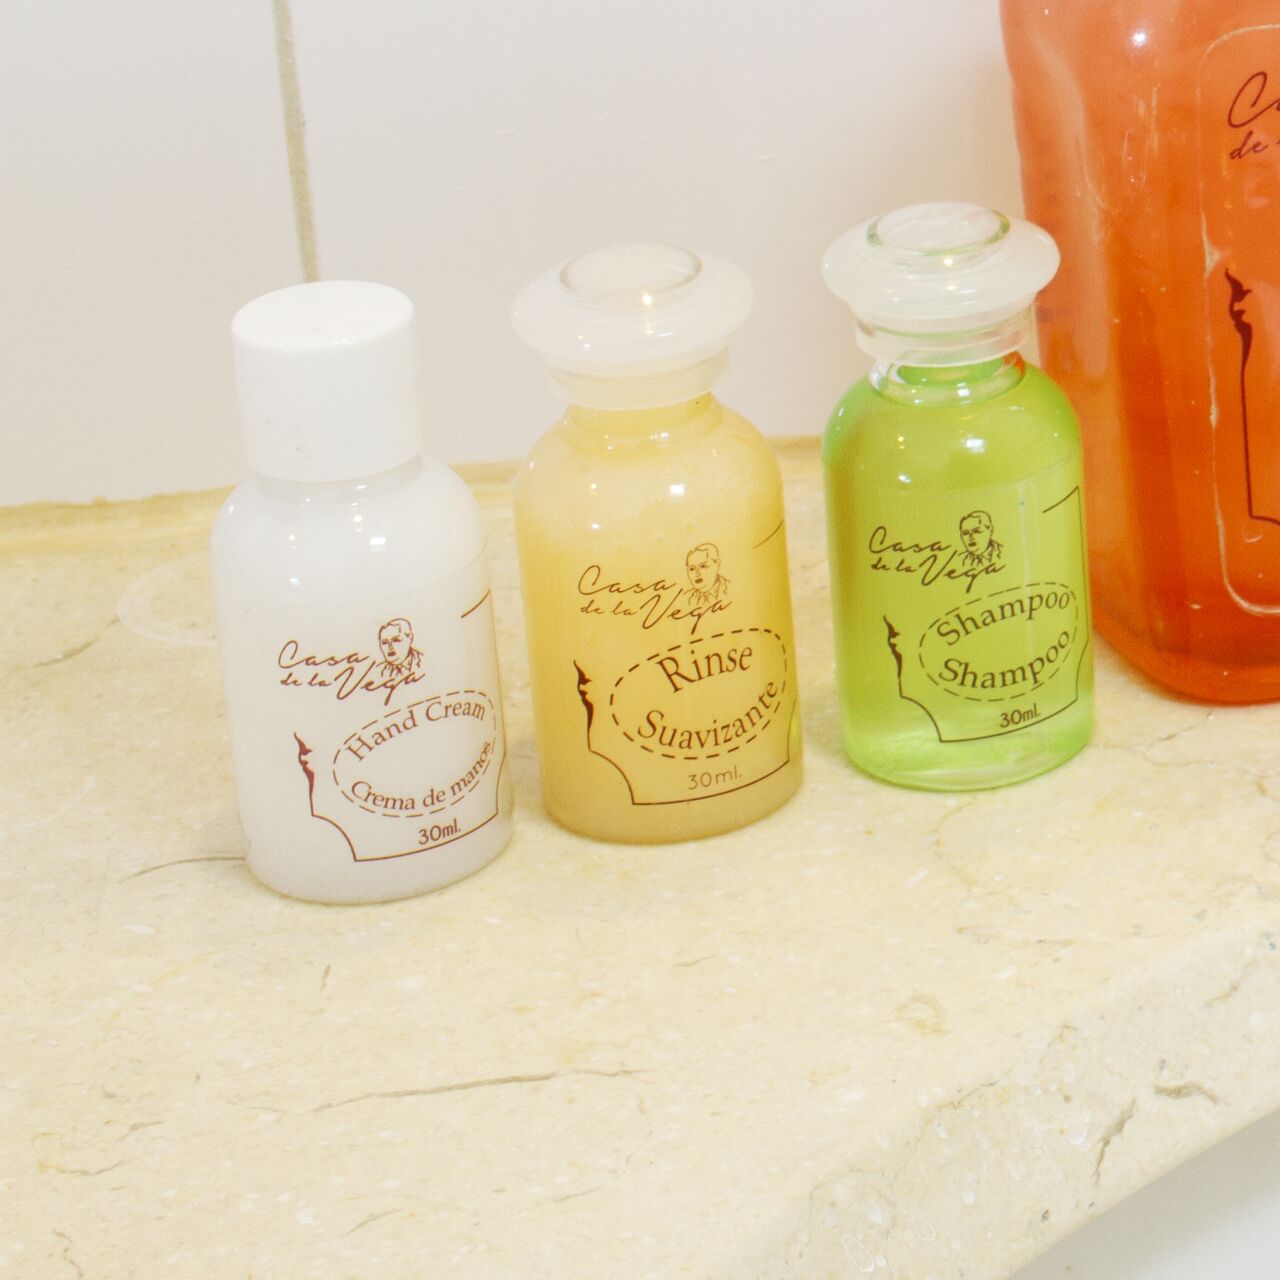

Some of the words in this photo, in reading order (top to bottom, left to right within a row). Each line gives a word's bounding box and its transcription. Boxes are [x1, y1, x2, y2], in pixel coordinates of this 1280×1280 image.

[1228, 132, 1268, 160] de
[869, 526, 951, 554] Casa
[577, 564, 677, 595] Casa
[870, 557, 890, 570] de
[895, 558, 917, 573] la
[919, 549, 1006, 594] Vega
[580, 599, 605, 615] de
[612, 600, 637, 616] la
[638, 587, 732, 635] Vega
[936, 591, 1071, 646] Shampoo
[278, 640, 370, 669] Casa
[656, 645, 753, 694] Rinse
[938, 631, 1070, 689] Shampoo
[280, 672, 302, 687] de
[306, 672, 332, 687] la
[334, 660, 426, 706] Vega
[345, 709, 418, 762] Hand
[424, 699, 486, 722] Cream
[636, 680, 778, 750] Suavizante
[350, 780, 416, 812] Crema
[422, 788, 446, 808] de
[449, 740, 492, 799] manos
